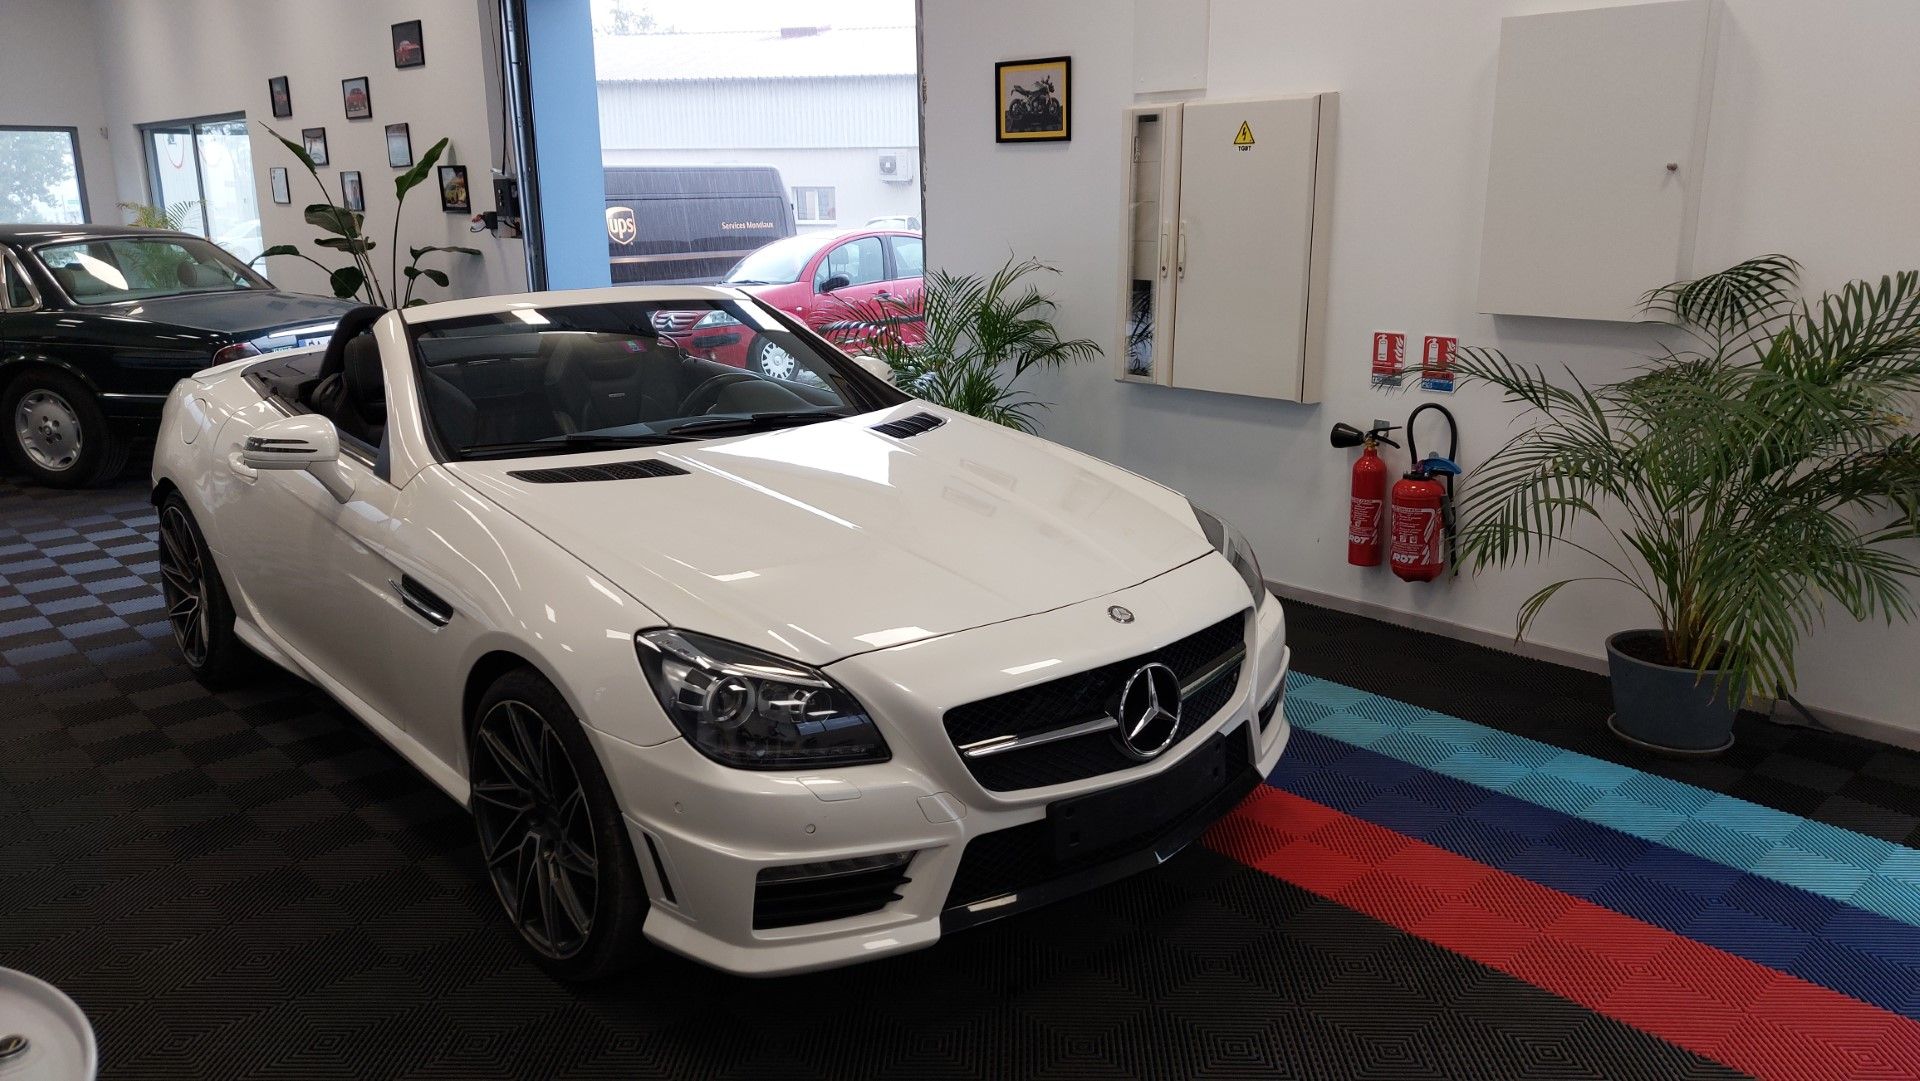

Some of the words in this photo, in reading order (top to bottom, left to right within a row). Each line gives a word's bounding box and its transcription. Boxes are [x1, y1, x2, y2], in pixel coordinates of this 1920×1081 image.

[609, 218, 634, 239] ups
[721, 221, 746, 230] Services
[1392, 552, 1420, 564] ROT
